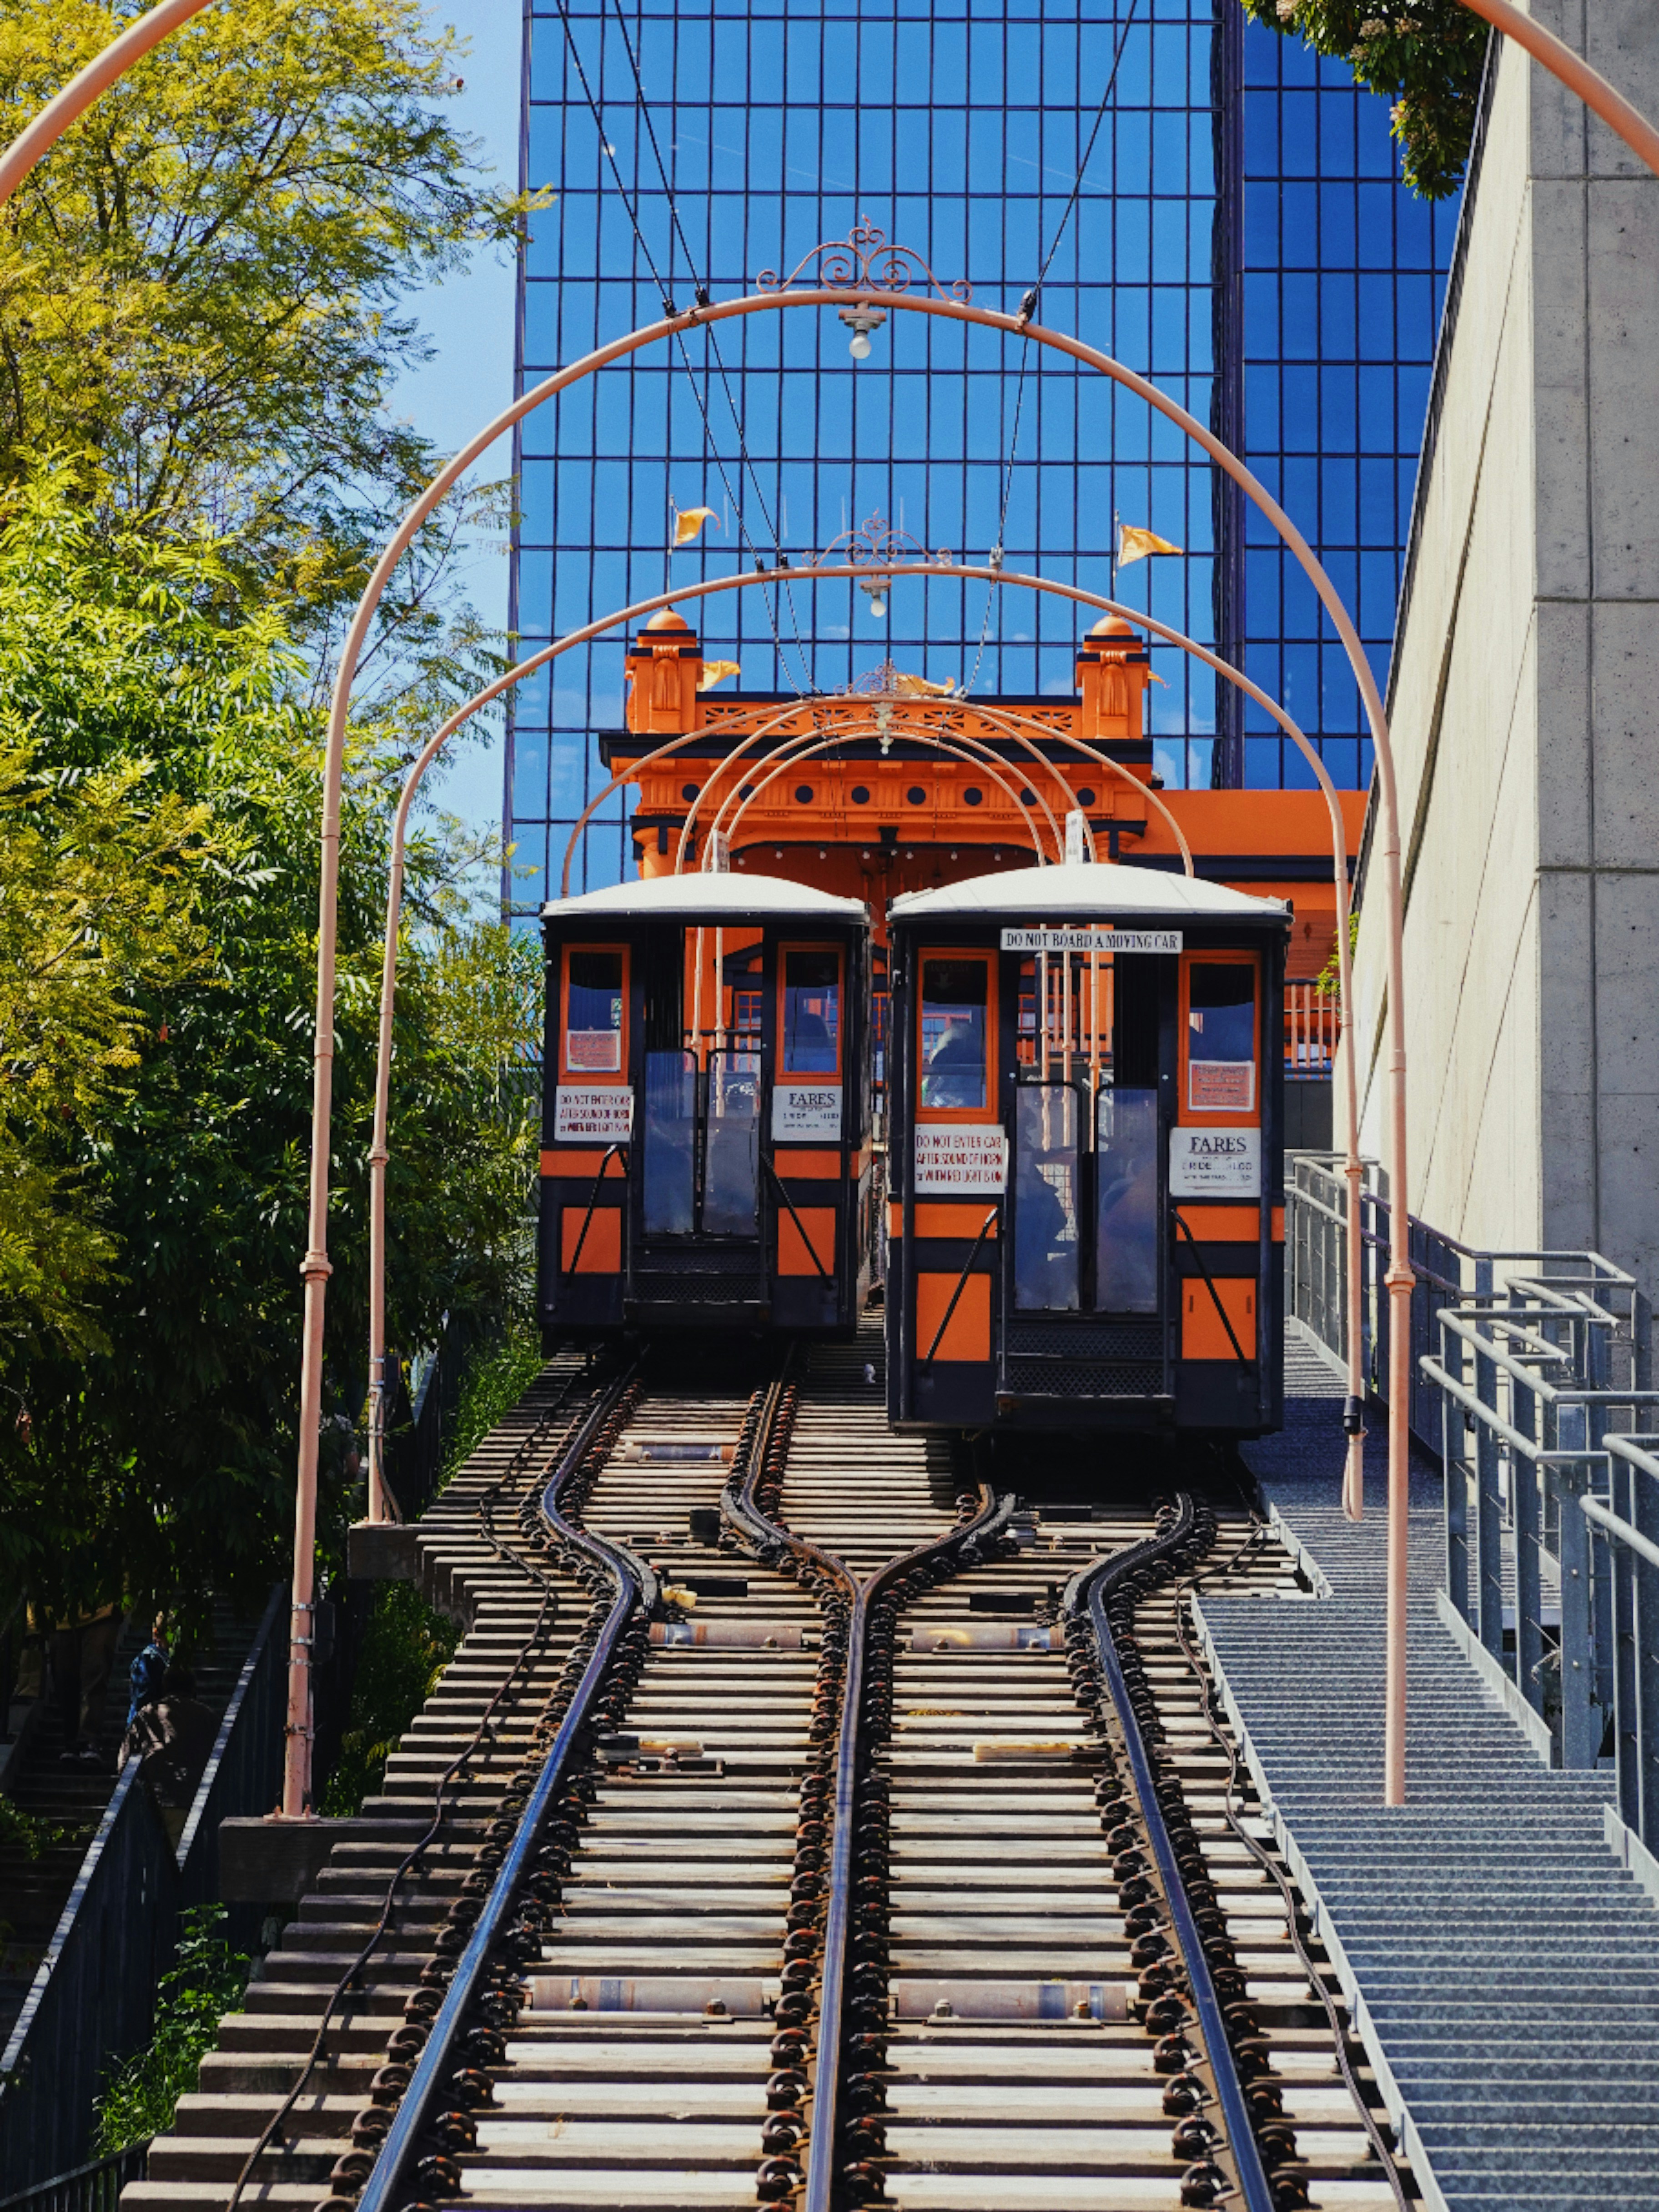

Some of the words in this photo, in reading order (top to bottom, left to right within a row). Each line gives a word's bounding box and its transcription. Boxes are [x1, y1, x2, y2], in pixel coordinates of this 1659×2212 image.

[1006, 932, 1022, 946] DO
[1026, 933, 1047, 947] NOT
[1052, 933, 1091, 948] BOARD
[1095, 934, 1104, 948] A
[1106, 935, 1152, 950] MOVING
[1155, 935, 1178, 950] CAR
[789, 1093, 835, 1105] FARES
[916, 1135, 930, 1148] DO
[933, 1135, 952, 1148] NOT
[954, 1136, 981, 1148] ENTER
[984, 1136, 1001, 1148] CAR
[1190, 1137, 1247, 1152] FARES
[916, 1153, 939, 1164] AFTER
